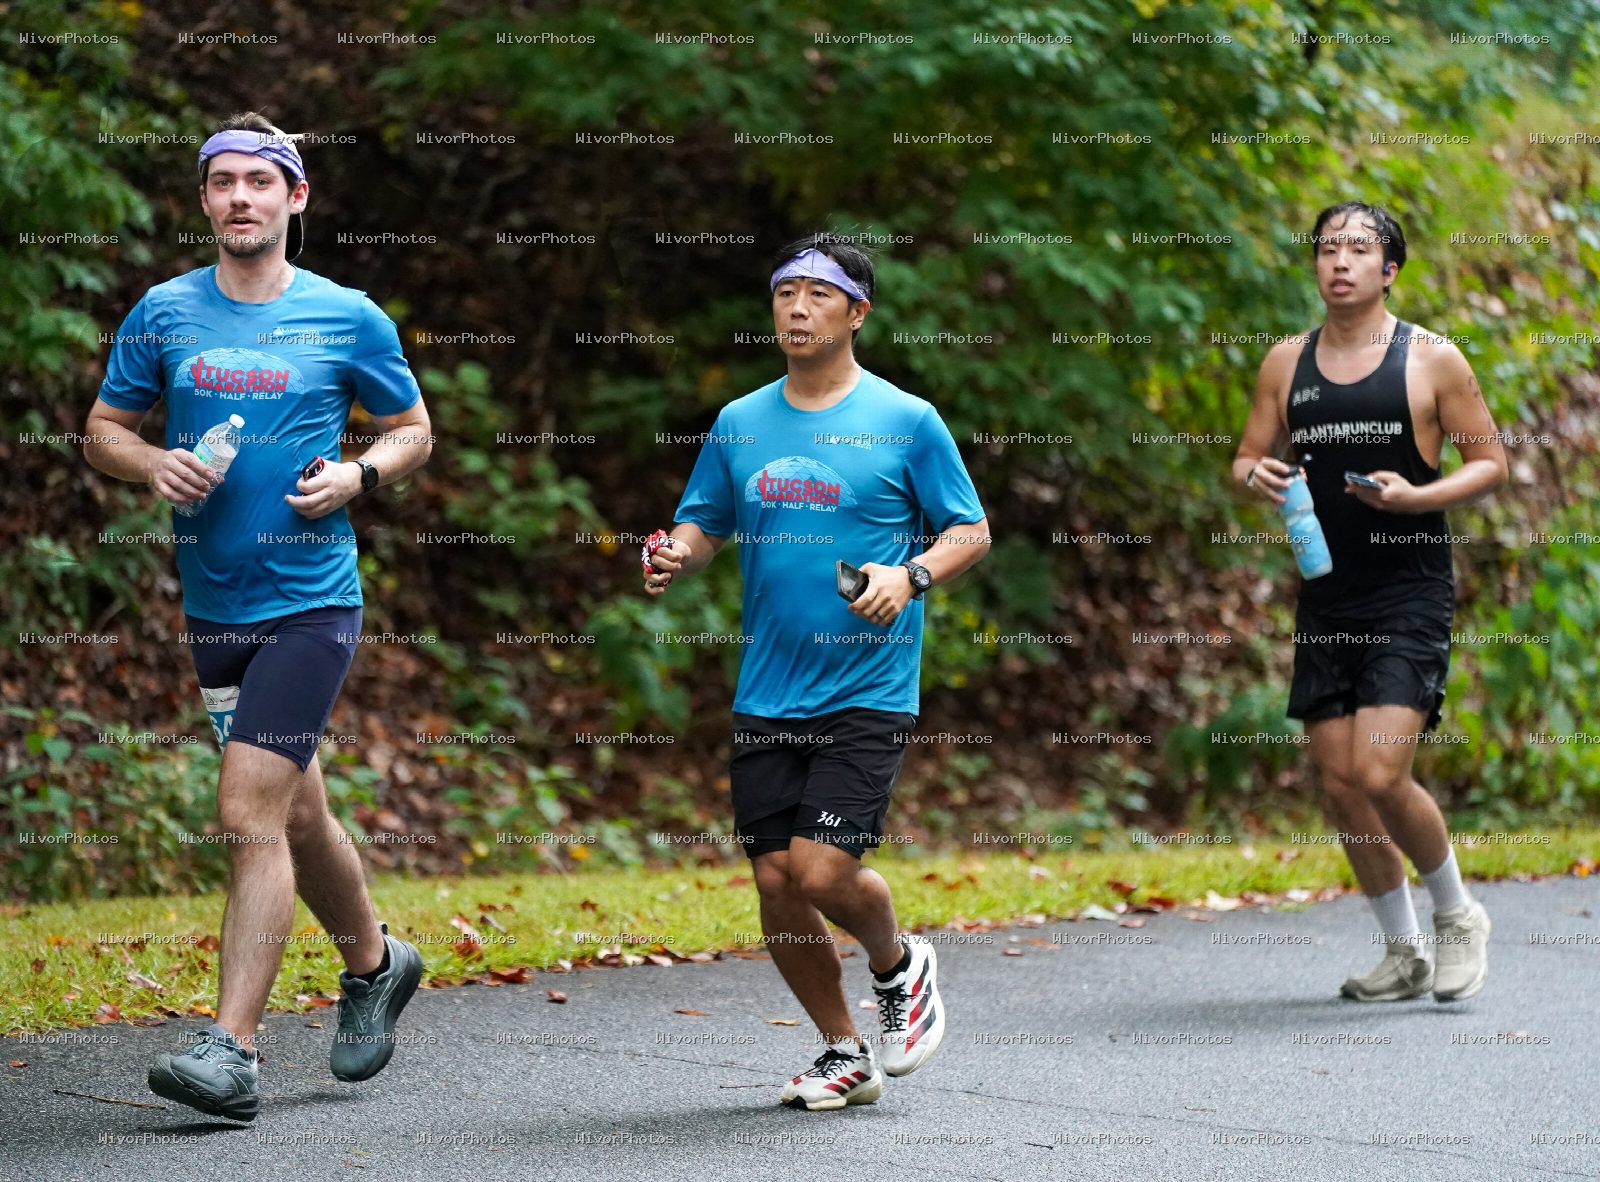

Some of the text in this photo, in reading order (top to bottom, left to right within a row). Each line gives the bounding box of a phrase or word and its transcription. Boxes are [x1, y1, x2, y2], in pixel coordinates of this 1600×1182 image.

[204, 366, 289, 384] TUCSON
[201, 380, 286, 392] MARATHON
[194, 389, 284, 401] 50K HALF RELAY
[767, 477, 840, 496] TUCSON
[767, 491, 839, 506] MARATHON
[761, 501, 837, 513] 50K HALF RELAY
